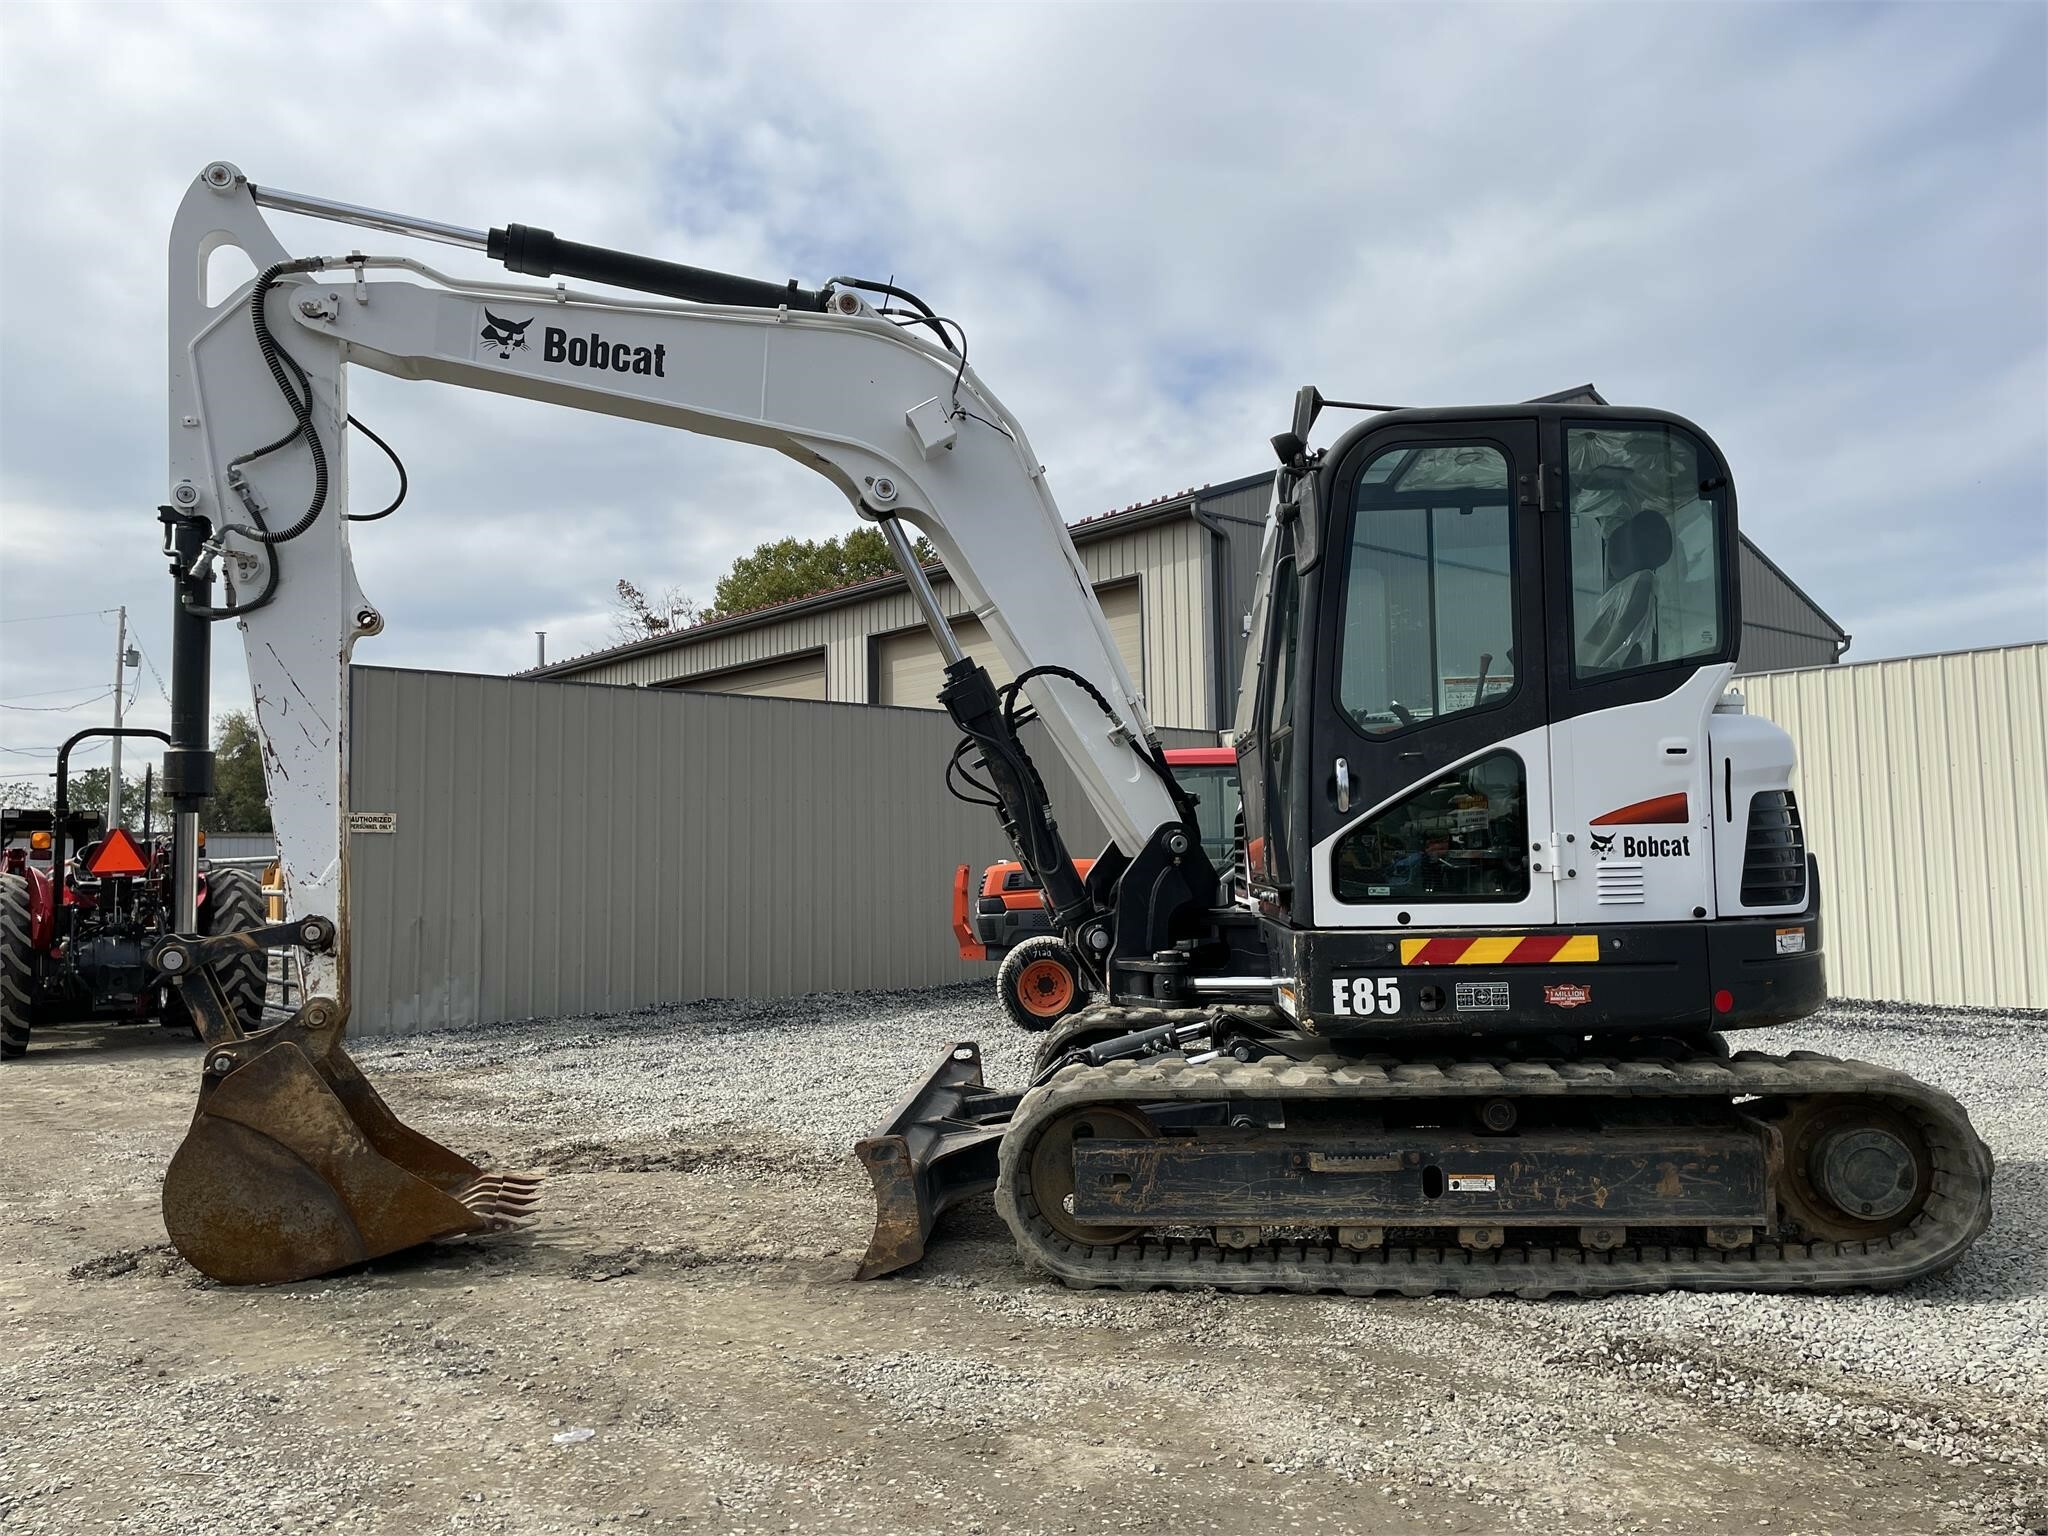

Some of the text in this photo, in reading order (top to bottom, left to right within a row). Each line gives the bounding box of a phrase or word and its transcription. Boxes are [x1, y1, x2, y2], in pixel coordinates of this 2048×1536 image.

[543, 326, 666, 378] Bobcat
[1623, 836, 1690, 858] Bobcat
[1331, 977, 1401, 1016] E85
